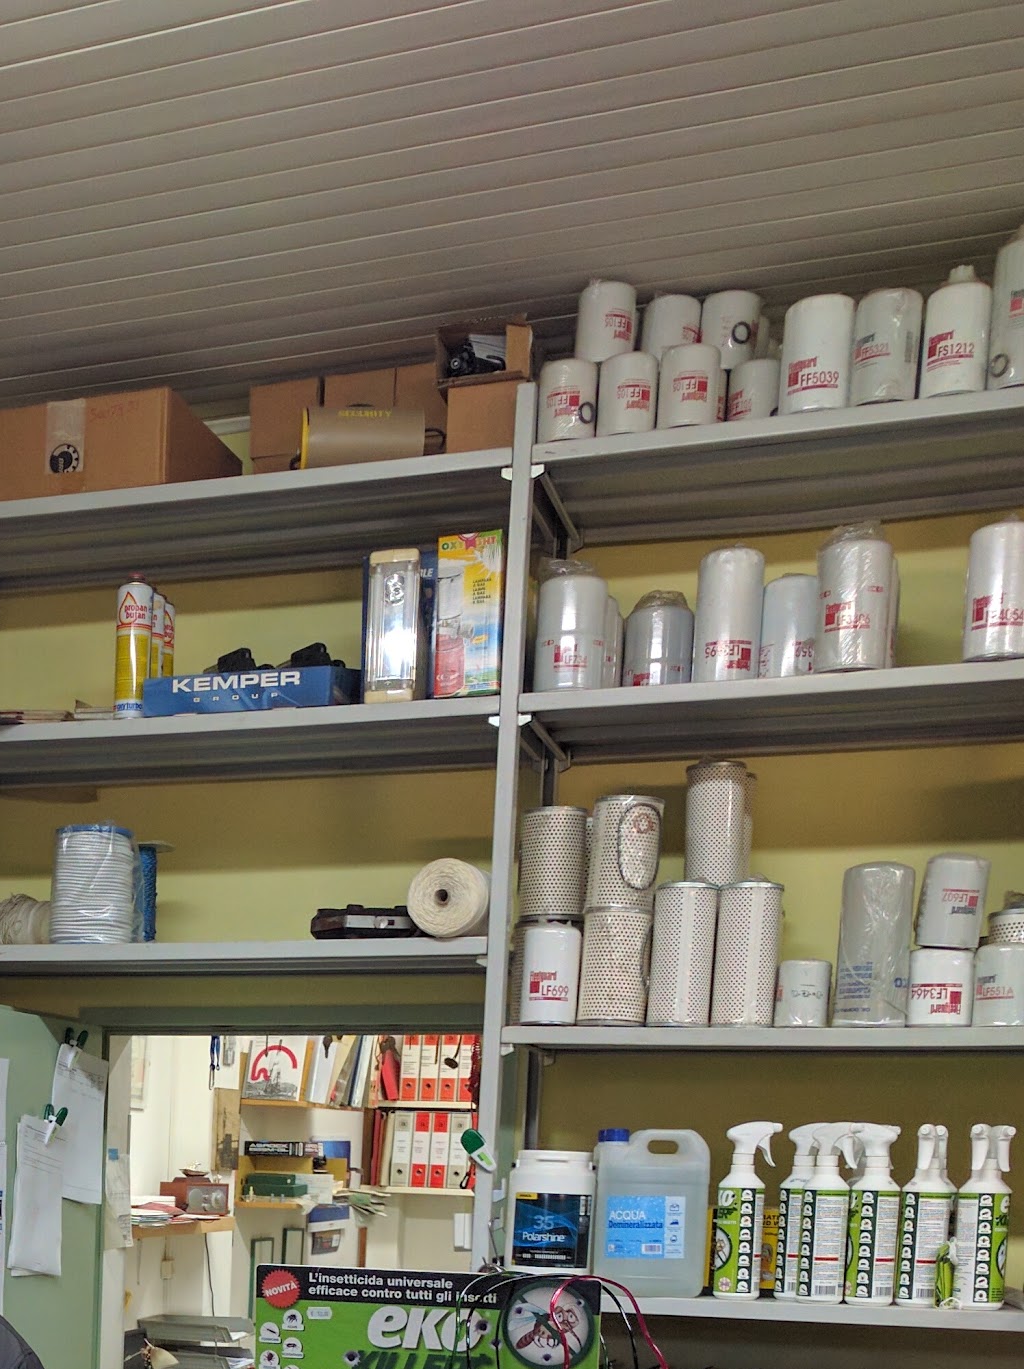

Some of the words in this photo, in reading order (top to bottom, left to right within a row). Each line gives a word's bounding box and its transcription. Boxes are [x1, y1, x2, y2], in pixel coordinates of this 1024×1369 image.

[937, 343, 975, 357] FS1212
[800, 371, 839, 386] FF5039
[172, 671, 301, 693] KEMPER
[194, 692, 279, 703] GROUP
[542, 985, 569, 996] LF699
[911, 987, 948, 999] LF3464
[533, 1215, 555, 1229] 35
[609, 1211, 646, 1221] ACQUA
[608, 1220, 663, 1229] Demineralizzata
[522, 1232, 563, 1242] Polarshine
[265, 1281, 298, 1297] NOVITÀ
[387, 1277, 453, 1289] universale
[309, 1287, 358, 1297] efficace
[362, 1289, 402, 1298] contro
[406, 1290, 432, 1300] tutti
[436, 1291, 452, 1303] gli
